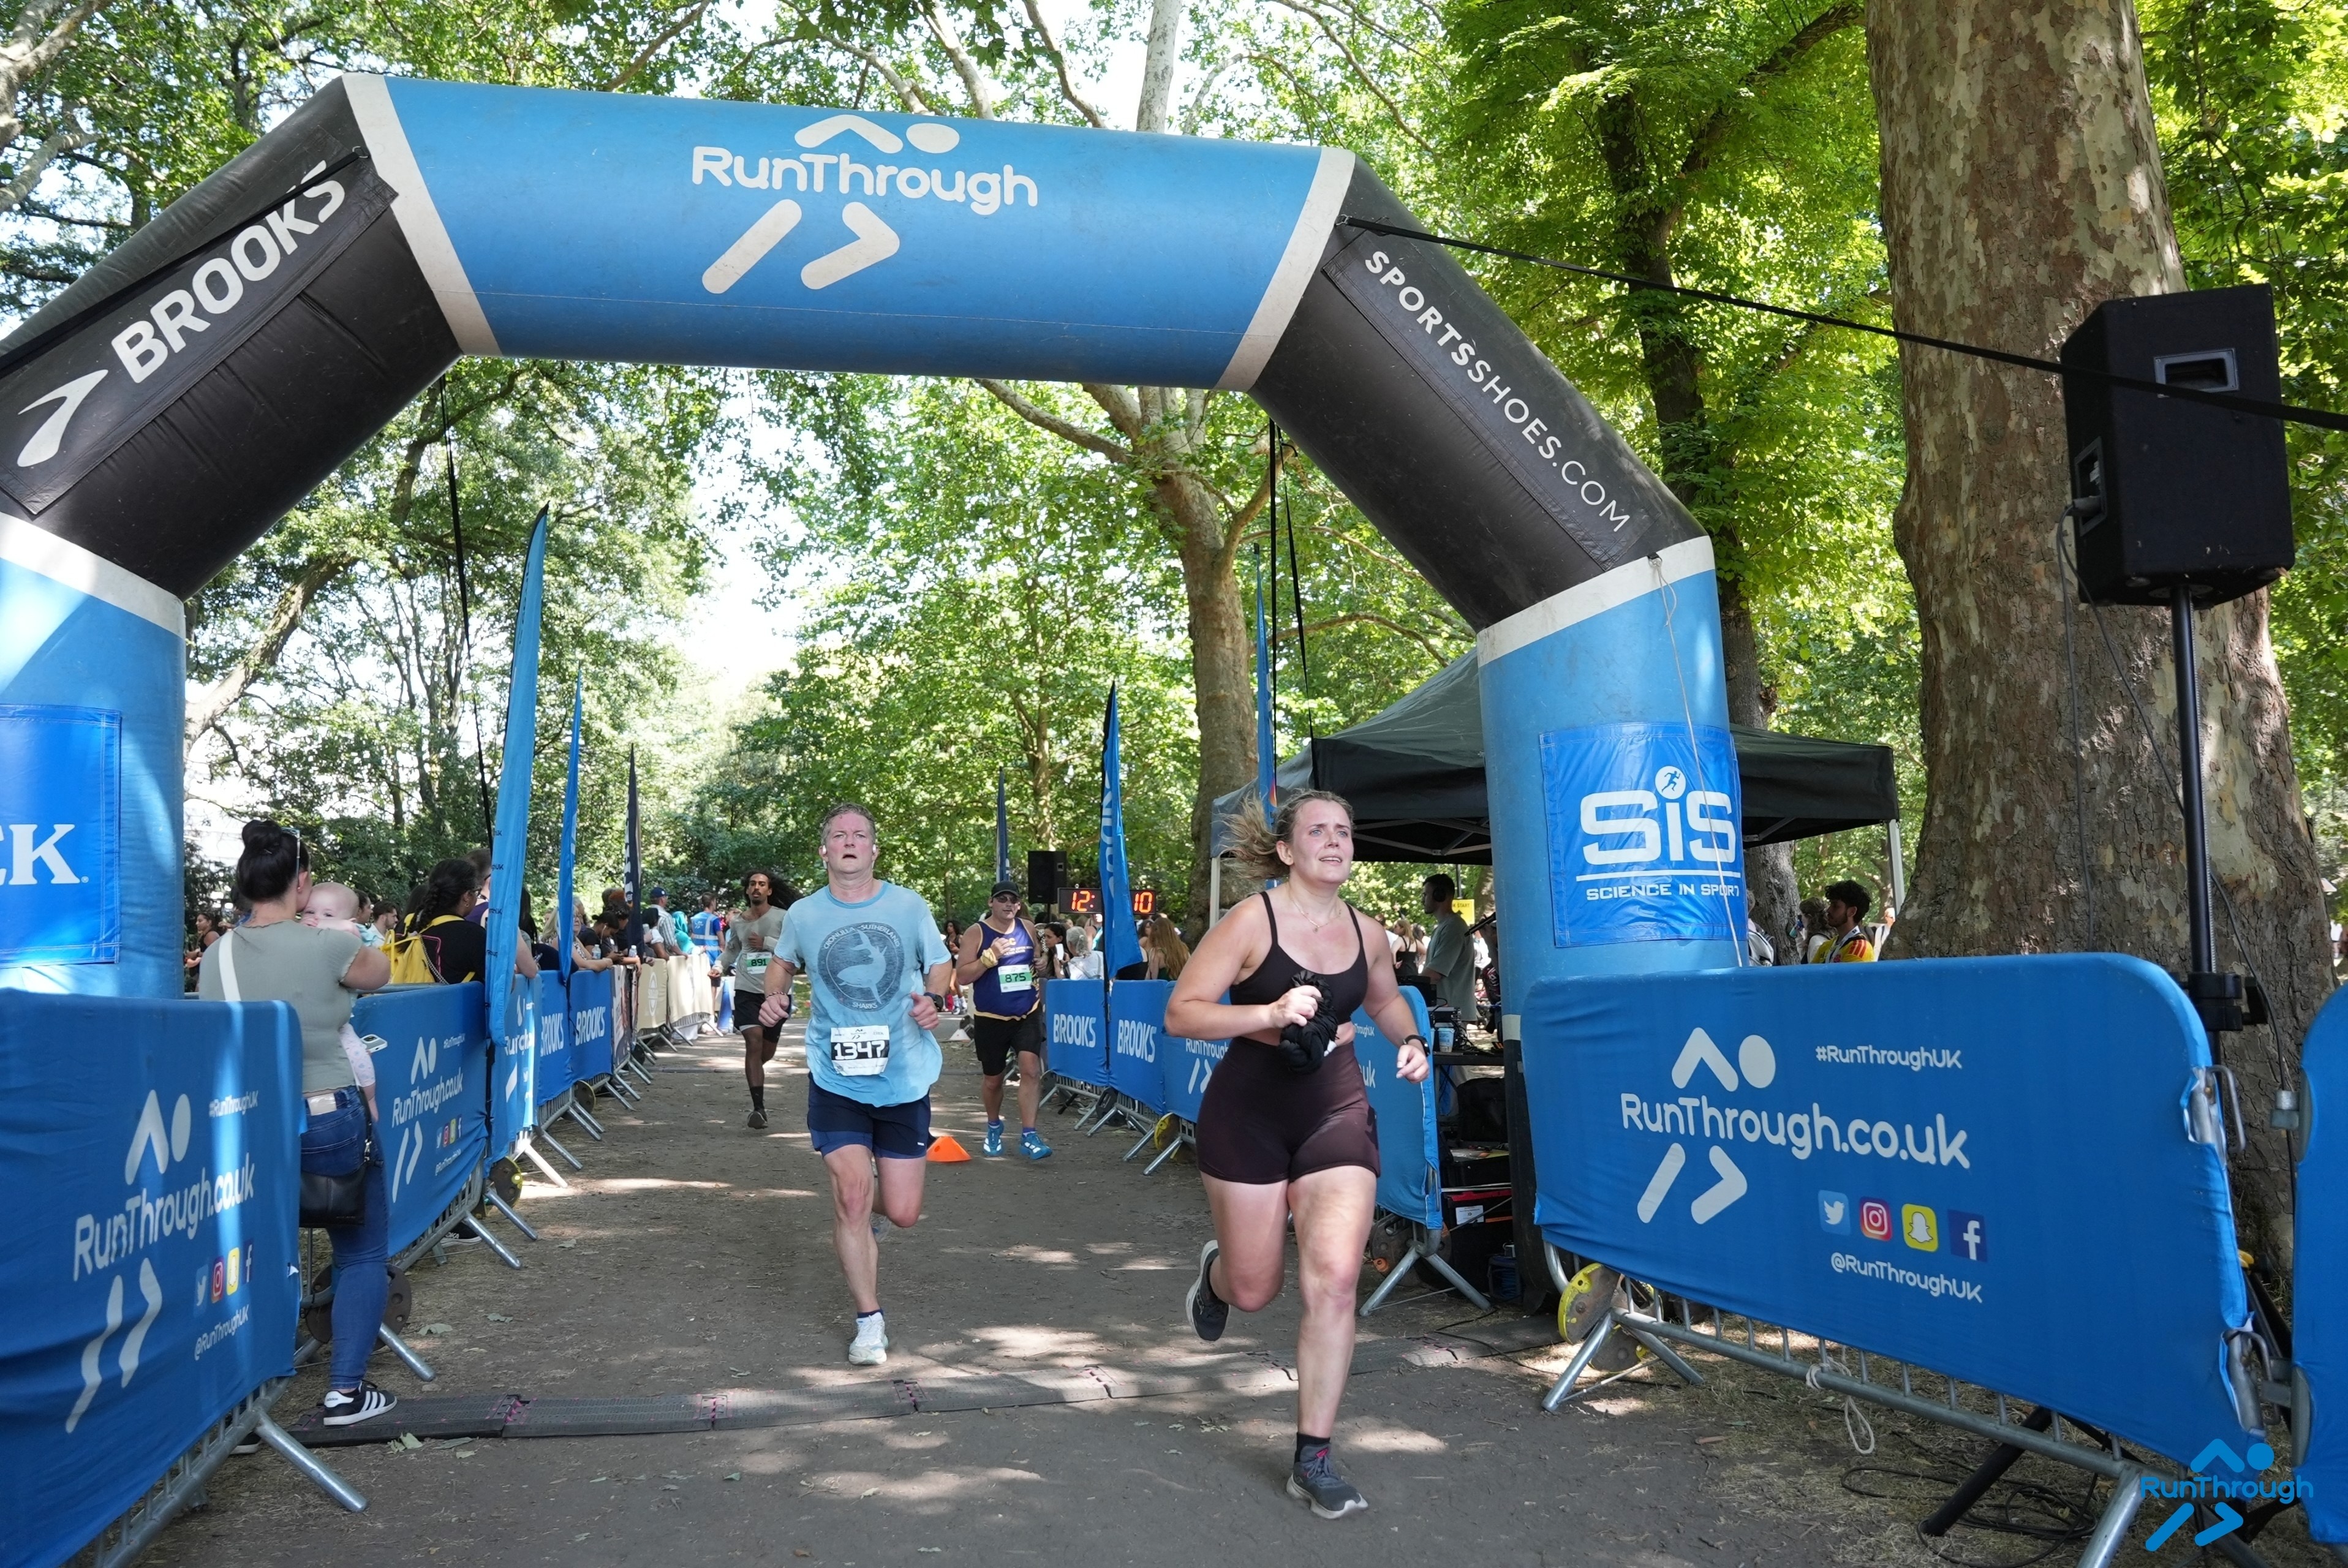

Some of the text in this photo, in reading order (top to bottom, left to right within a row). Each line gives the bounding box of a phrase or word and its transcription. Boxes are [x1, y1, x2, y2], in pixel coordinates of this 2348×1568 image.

[692, 146, 1038, 215] RunThrough
[111, 160, 345, 383] BROOKS
[1365, 251, 1630, 532] SPORTSSHOES.COM
[1580, 766, 1736, 865] SiS
[0, 823, 81, 886] K
[1134, 892, 1152, 913] 10
[1586, 884, 1739, 900] SCIENCE IN SPORT
[1005, 973, 1026, 982] 875
[575, 1006, 606, 1046] BROOKS
[834, 1040, 886, 1060] 1347
[1054, 1014, 1097, 1048] BROOKS
[1117, 1019, 1157, 1063] BROOKS
[1815, 1044, 1962, 1071] #RunThroughUK
[392, 1066, 464, 1128] RunThrough.co.uk
[1621, 1093, 1970, 1168] RunThrough.co.uk
[73, 1152, 255, 1282] RunThrough.co.uk
[1831, 1252, 1984, 1303] @RunThroughUK
[194, 1304, 249, 1361] @RunThroughUK
